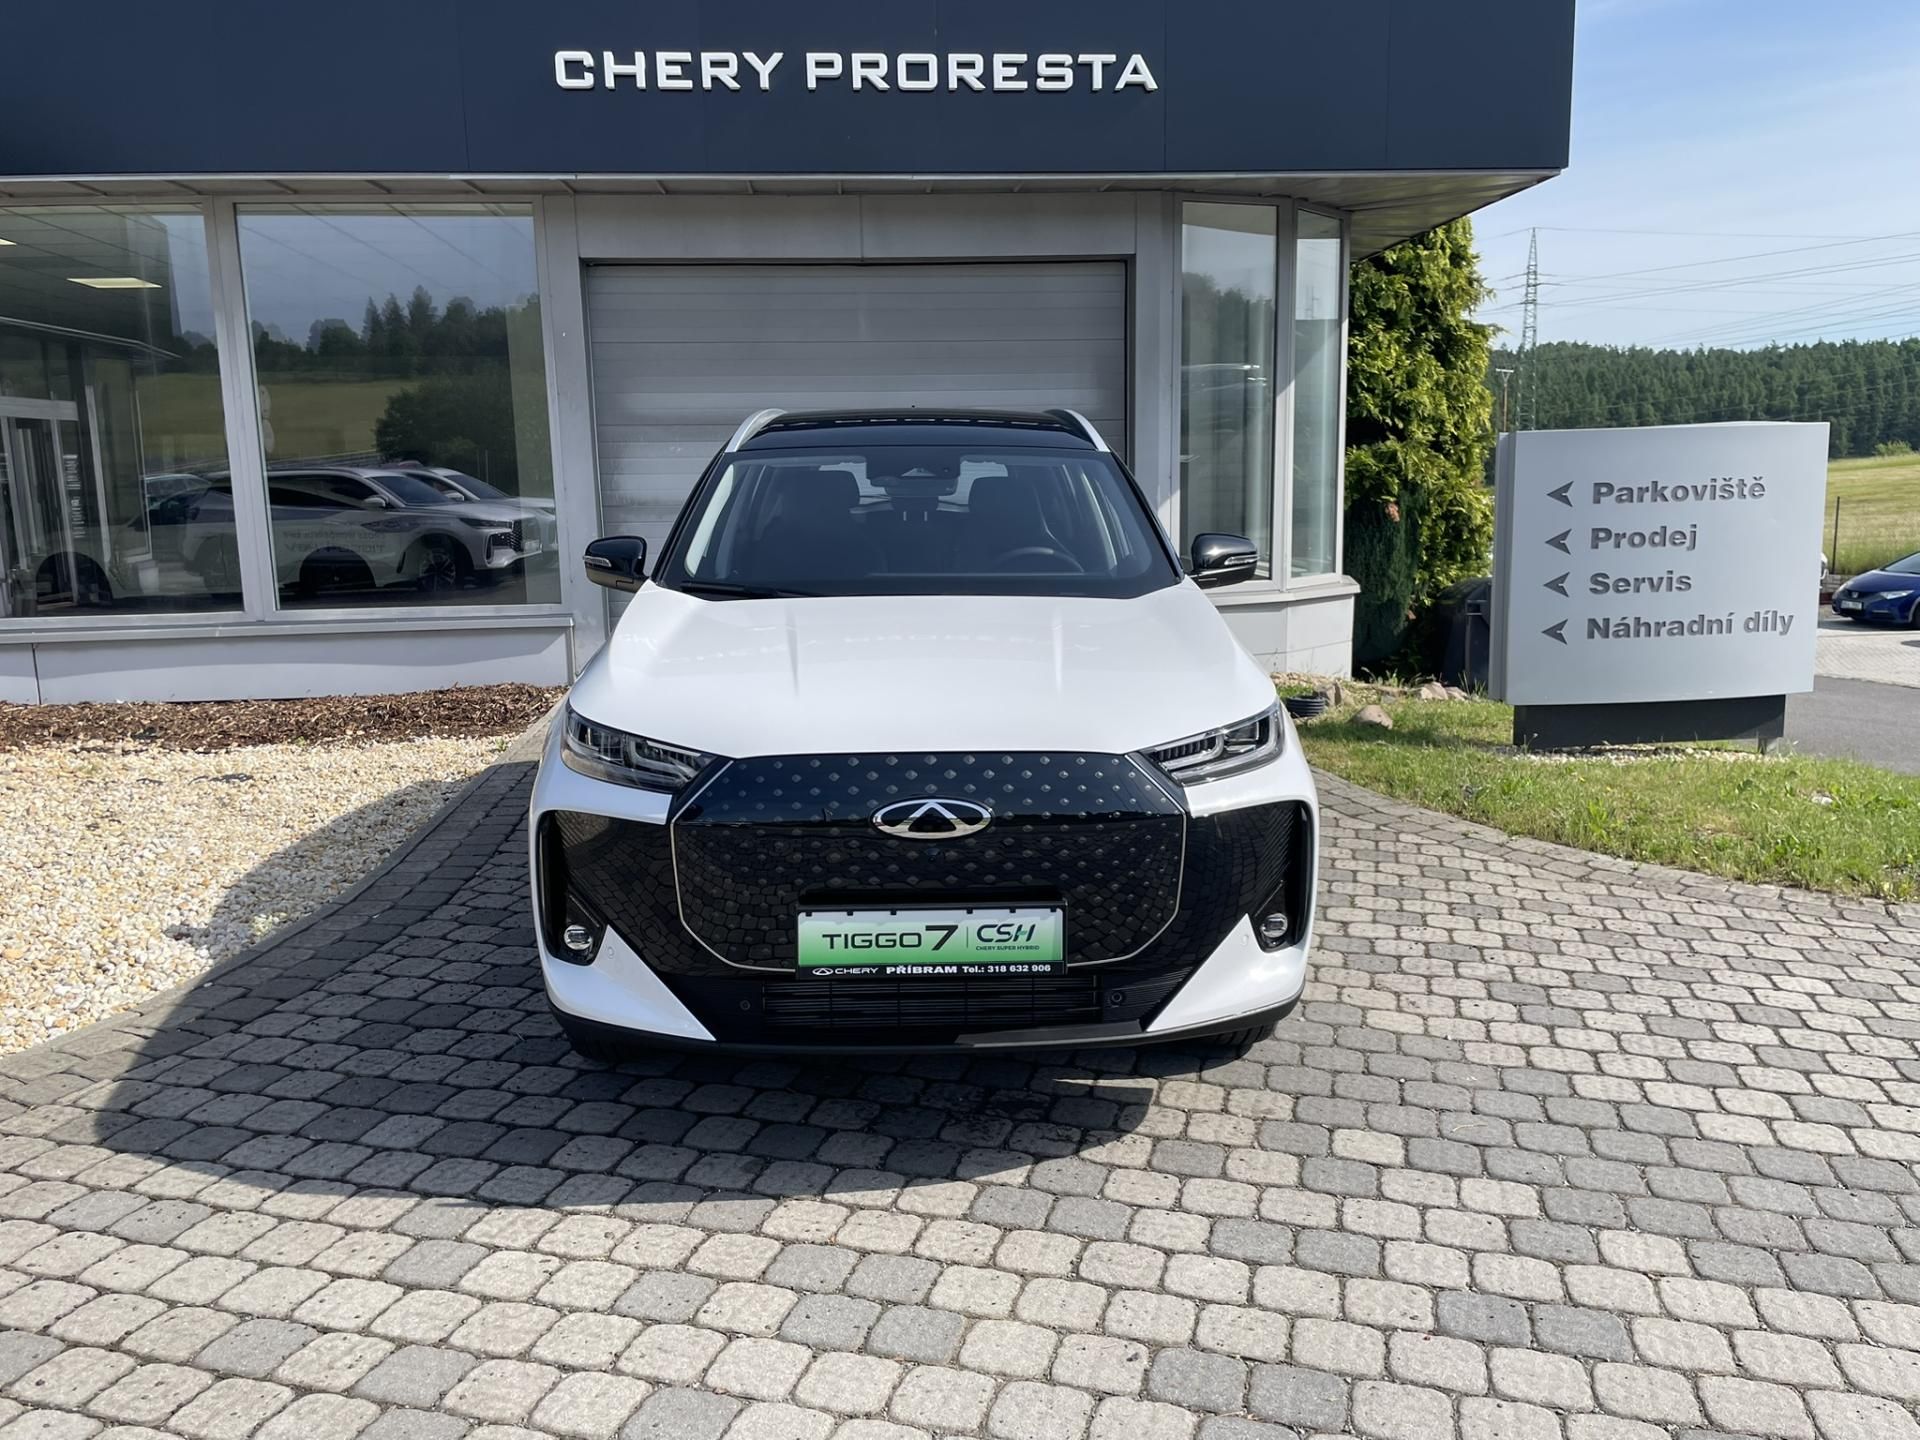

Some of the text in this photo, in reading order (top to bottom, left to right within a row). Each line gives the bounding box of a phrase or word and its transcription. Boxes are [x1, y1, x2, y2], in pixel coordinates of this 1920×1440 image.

[555, 50, 1158, 92] CHERY PRORESTA
[1592, 476, 1767, 505] Parkoviště
[1590, 524, 1698, 551] Prodej
[1588, 570, 1692, 596] Servis
[1586, 610, 1794, 640] Náhradní díly
[822, 924, 958, 951] TIGGO 7
[976, 923, 1036, 942] CSH
[835, 967, 879, 975] CHERY
[886, 964, 957, 975] PŘÍBRAM
[962, 965, 985, 974] Tel.:
[987, 965, 1006, 973] 318
[1009, 964, 1028, 973] 632
